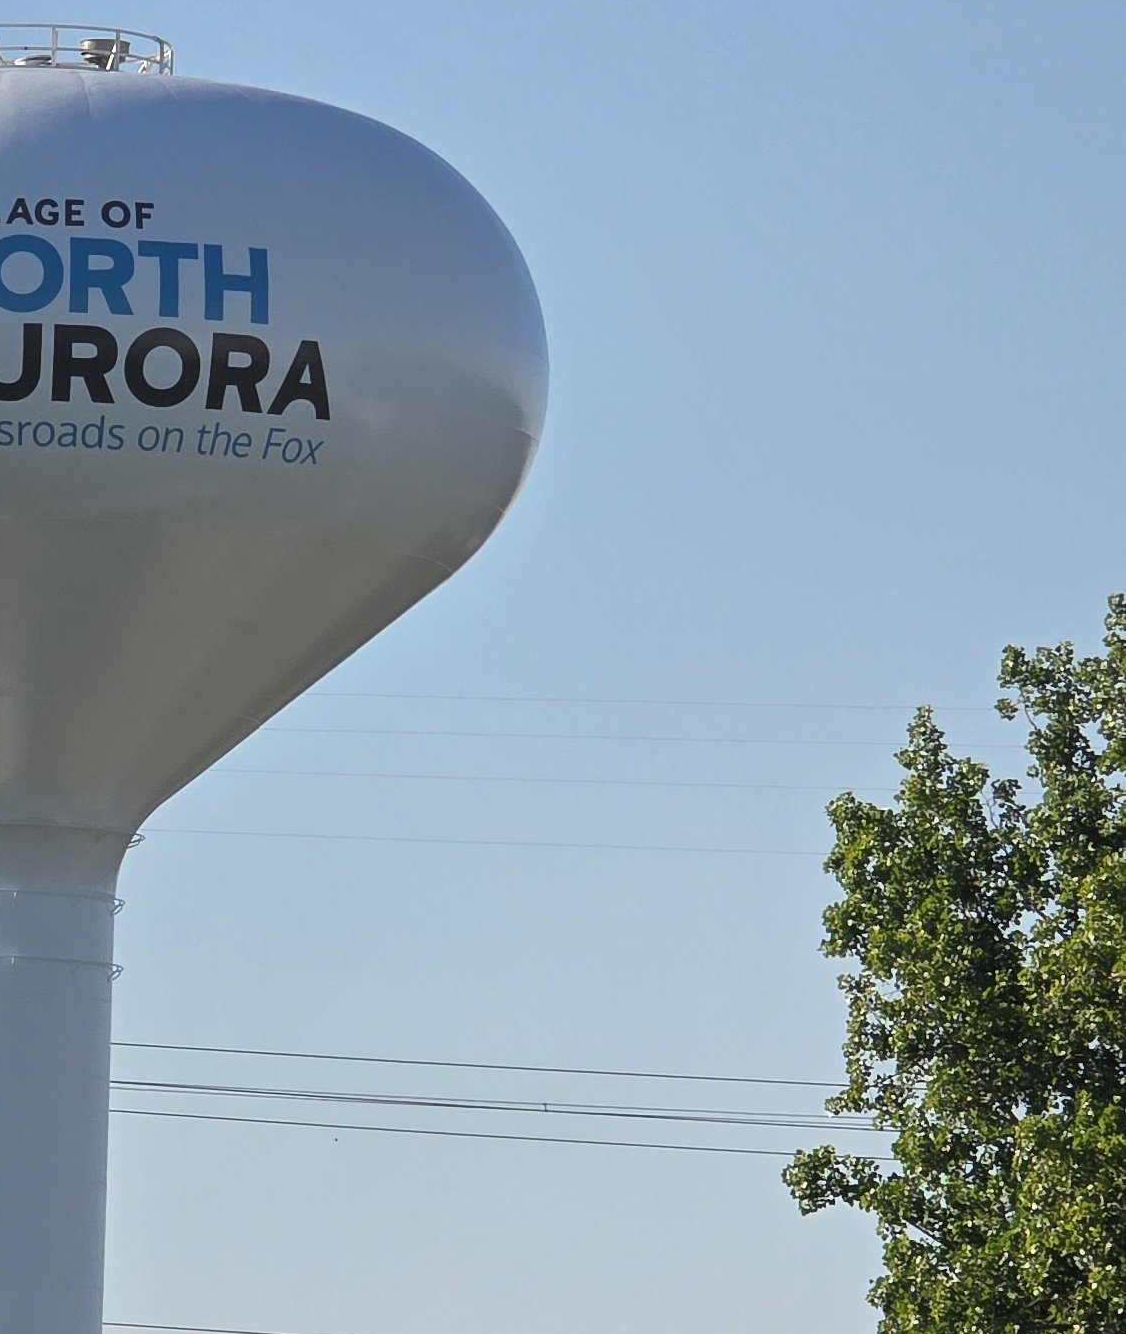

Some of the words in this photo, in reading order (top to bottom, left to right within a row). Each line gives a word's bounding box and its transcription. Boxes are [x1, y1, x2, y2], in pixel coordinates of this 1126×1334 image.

[101, 199, 155, 229] OF
[138, 424, 185, 453] on
[196, 421, 253, 459] the
[262, 427, 324, 465] Fox
